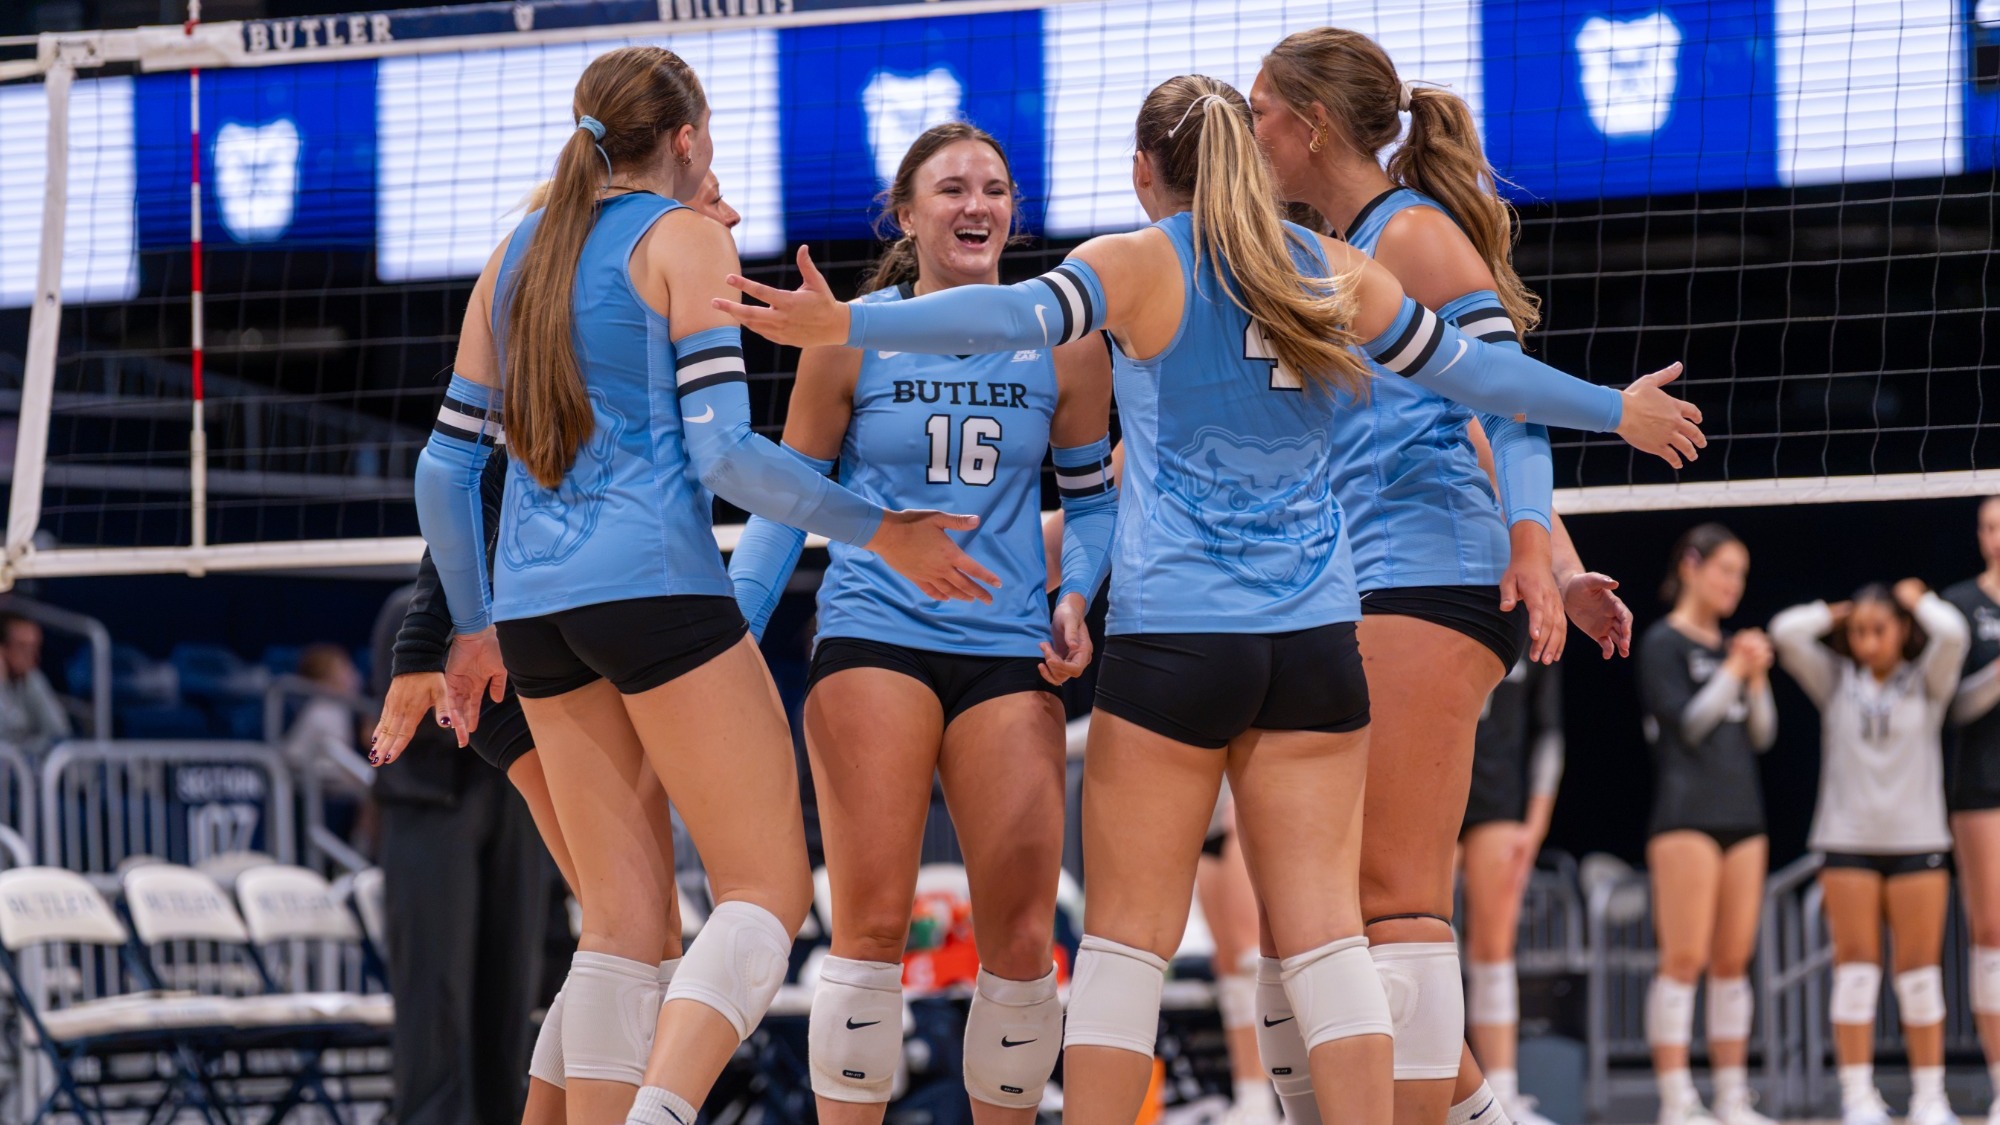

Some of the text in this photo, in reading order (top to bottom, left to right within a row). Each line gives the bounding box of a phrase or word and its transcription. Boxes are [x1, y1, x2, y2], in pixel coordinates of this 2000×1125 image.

[249, 14, 394, 50] BUTLER
[893, 380, 1029, 409] BUTLER
[925, 414, 1002, 487] 16
